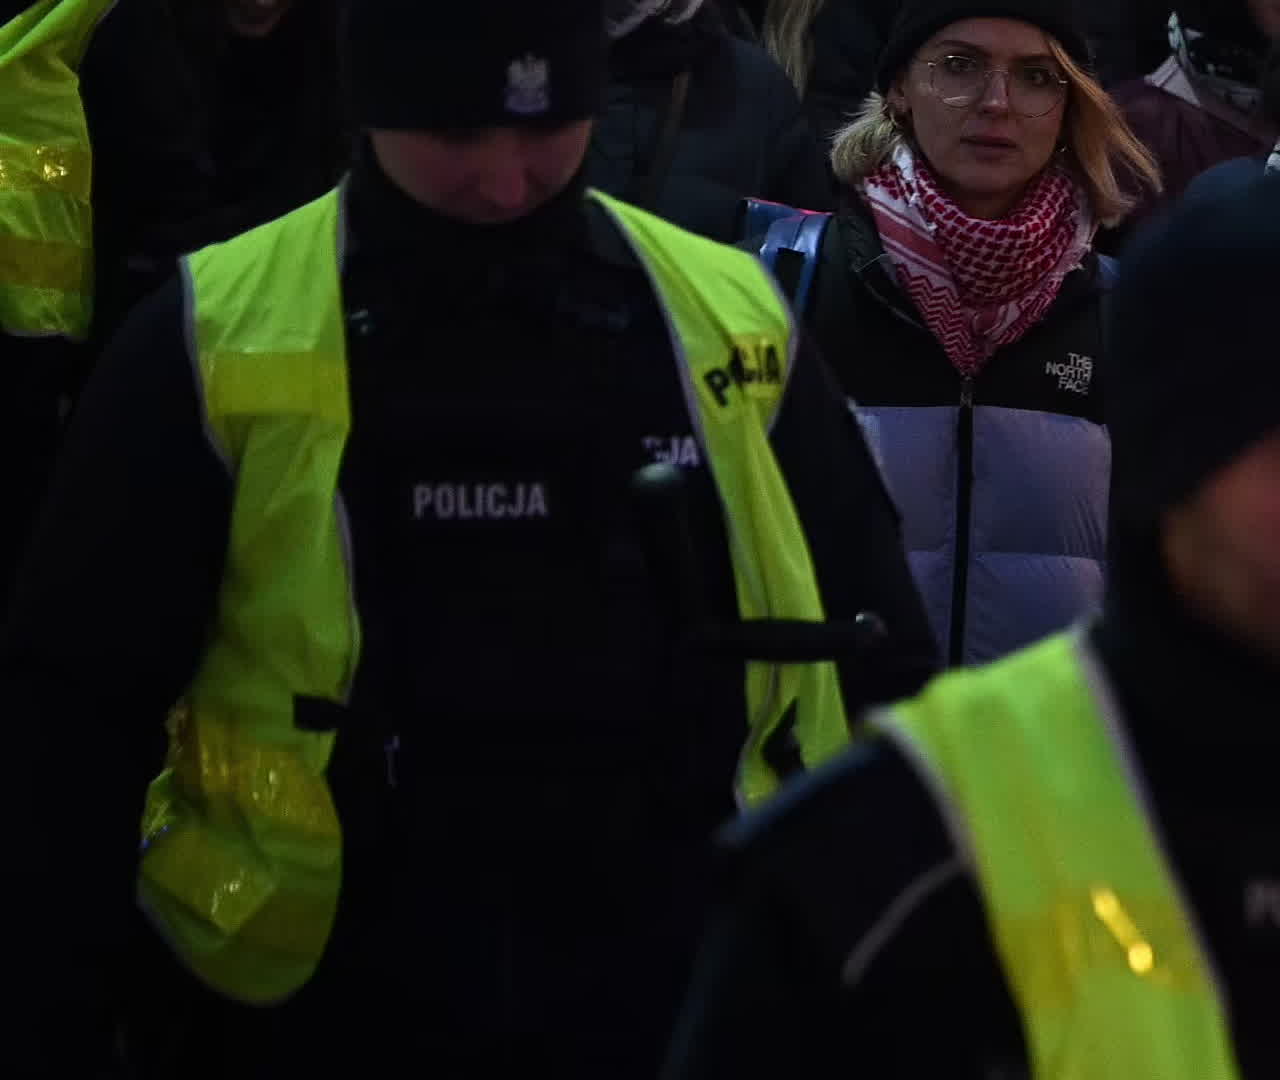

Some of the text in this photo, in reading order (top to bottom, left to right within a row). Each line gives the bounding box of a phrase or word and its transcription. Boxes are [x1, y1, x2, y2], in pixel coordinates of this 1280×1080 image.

[1045, 361, 1092, 383] NORTH
[1067, 352, 1093, 370] THE
[412, 481, 549, 520] POLICJA
